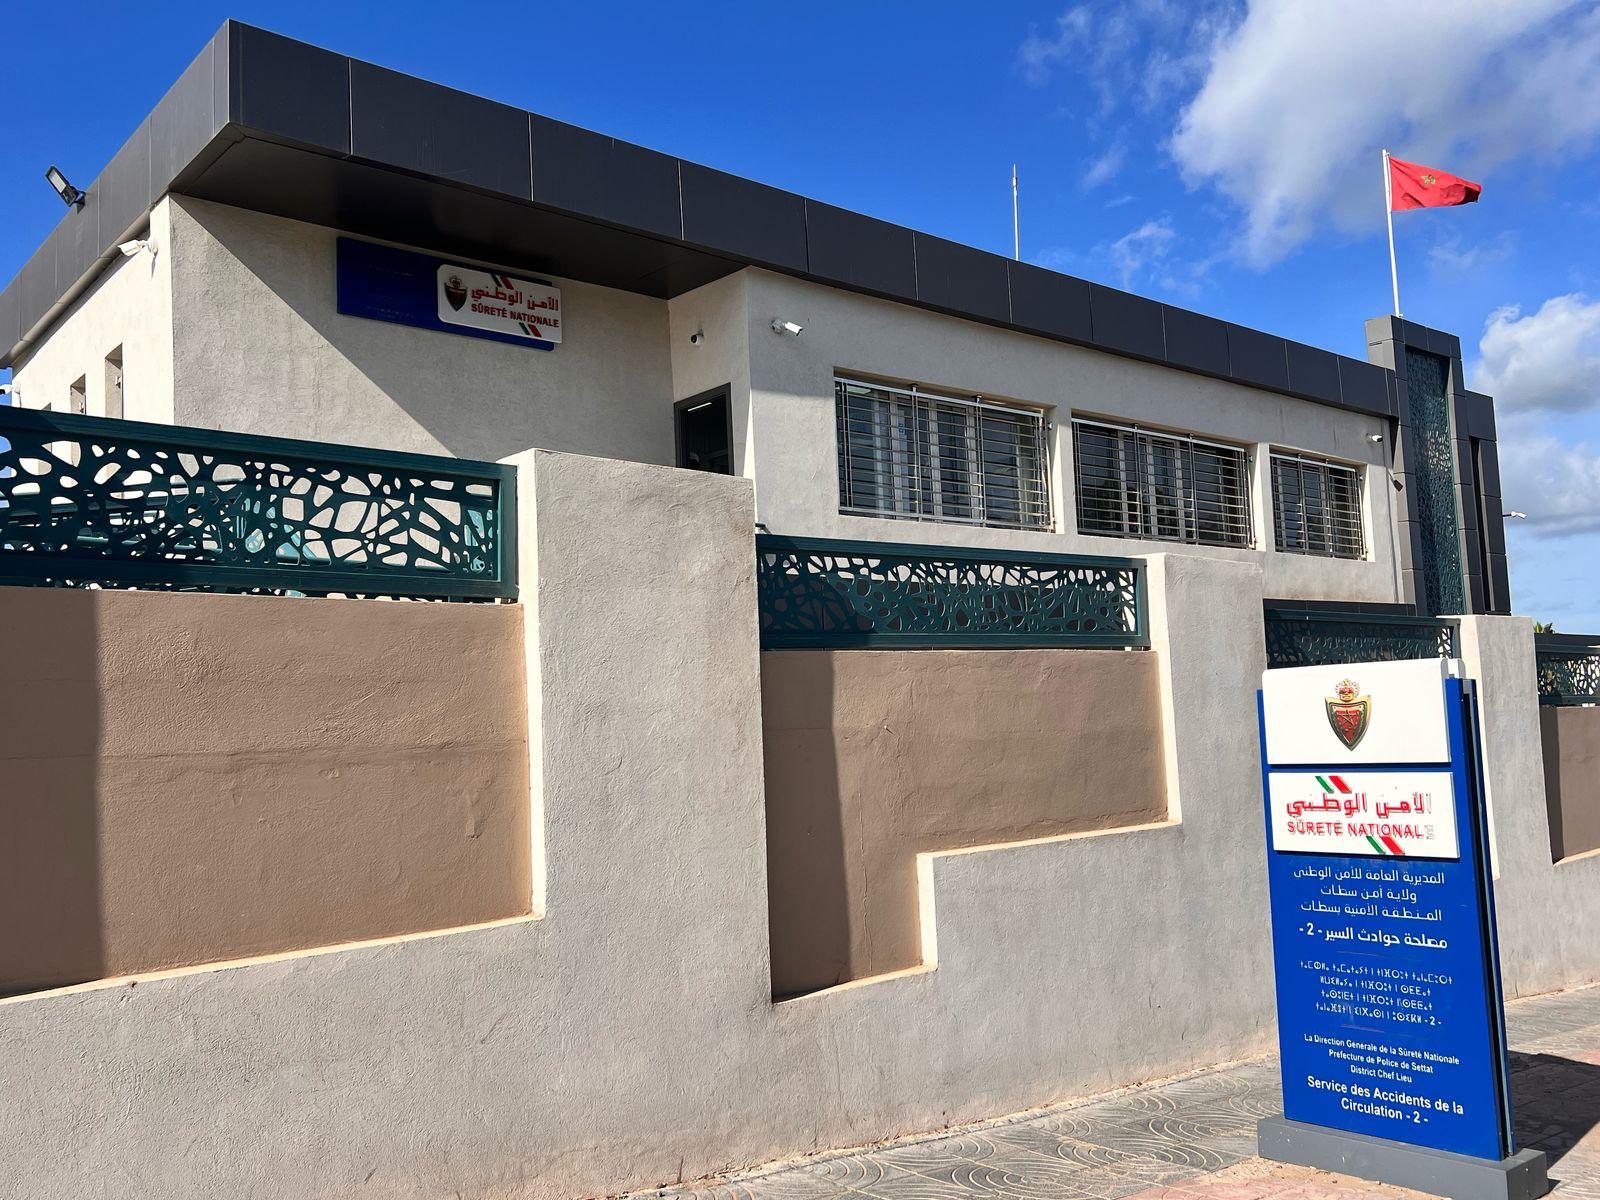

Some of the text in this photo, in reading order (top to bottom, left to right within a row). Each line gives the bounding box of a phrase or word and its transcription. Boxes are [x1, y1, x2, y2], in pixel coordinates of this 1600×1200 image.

[471, 286, 559, 311] الأمن الوطني
[471, 302, 559, 328] SÛRETÉ NATIONALE
[1365, 868, 1399, 881] العامة
[1402, 871, 1445, 886] المديرية
[1320, 883, 1417, 904] ولاية أمن سطات
[1300, 899, 1341, 916] بسطات
[1381, 906, 1442, 921] المنطقة
[1325, 926, 1354, 942] السير
[1357, 928, 1401, 947] حوادث
[1404, 932, 1448, 949] مصلحة
[1304, 1033, 1313, 1042] La
[1314, 1034, 1345, 1047] Direction
[1379, 1045, 1389, 1054] de
[1389, 1046, 1397, 1055] la
[1423, 1051, 1460, 1065] Nationale
[1350, 1064, 1413, 1083] District Chef Lieu
[1366, 1056, 1375, 1064] de
[1376, 1056, 1399, 1068] Police
[1400, 1061, 1410, 1070] de
[1411, 1061, 1434, 1074] Settat
[1307, 1075, 1465, 1115] Service des Accidents de la
[1341, 1097, 1403, 1120] Circulation
[1413, 1110, 1421, 1124] 2
